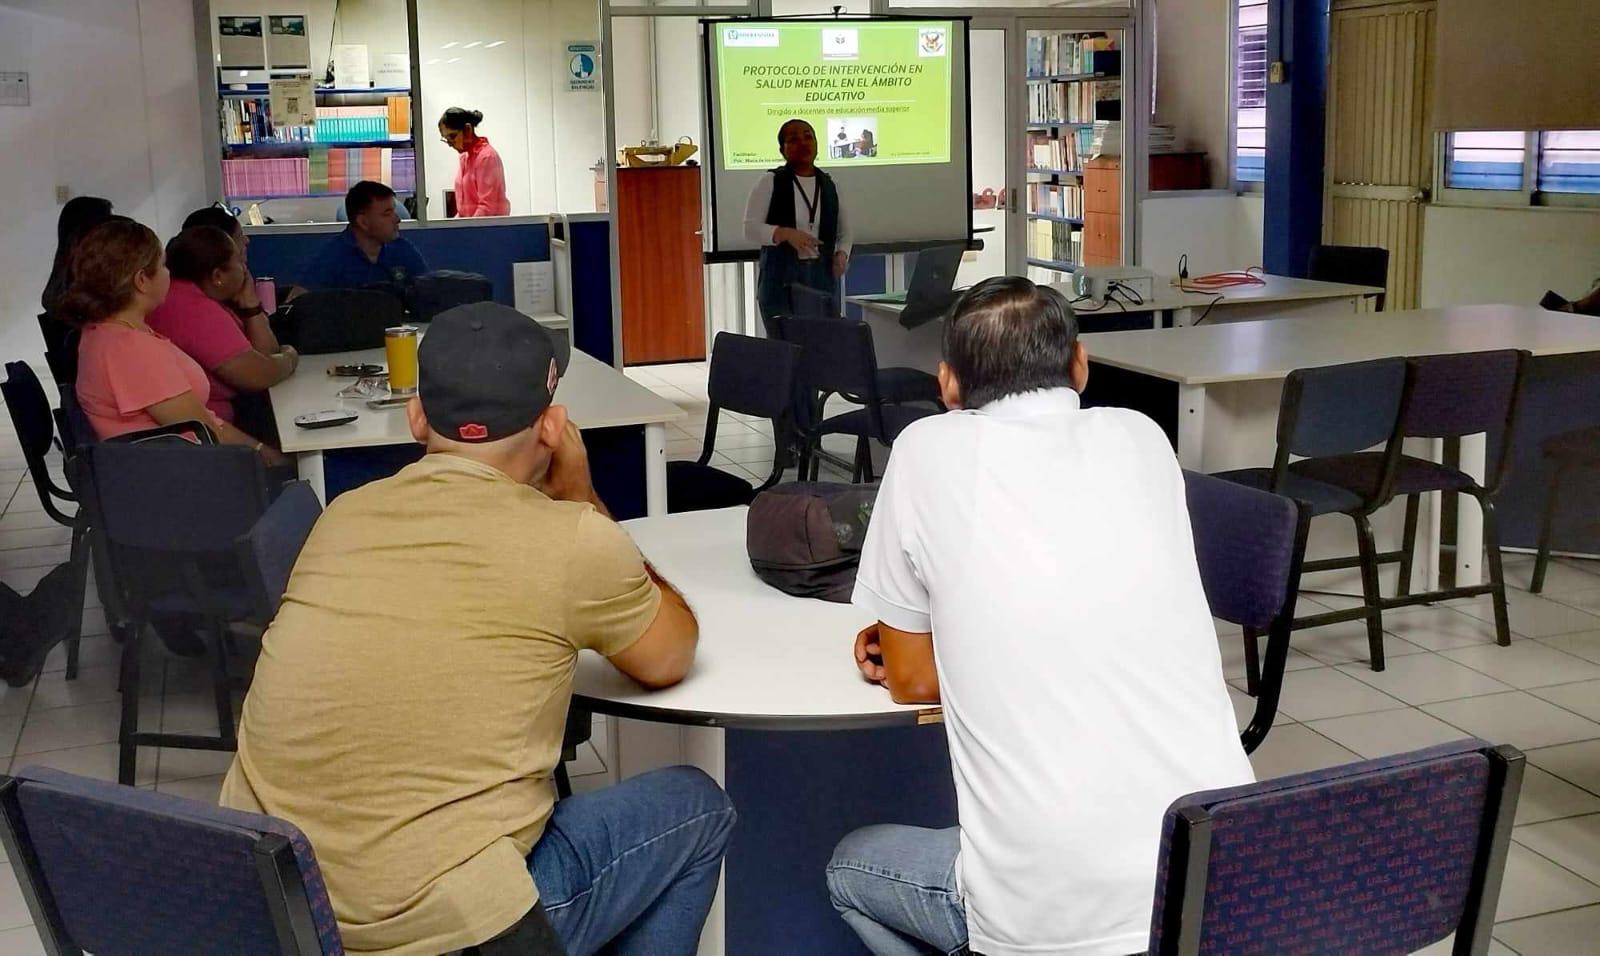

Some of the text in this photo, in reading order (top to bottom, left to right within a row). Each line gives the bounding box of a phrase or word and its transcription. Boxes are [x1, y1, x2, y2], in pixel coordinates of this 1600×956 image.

[743, 63, 924, 76] PROTOCOLO DE INTERVENCIÓN EN
[755, 75, 912, 89] SALUD MENTAL EN EL ÁMBITO
[805, 91, 866, 102] EDUCATIVO
